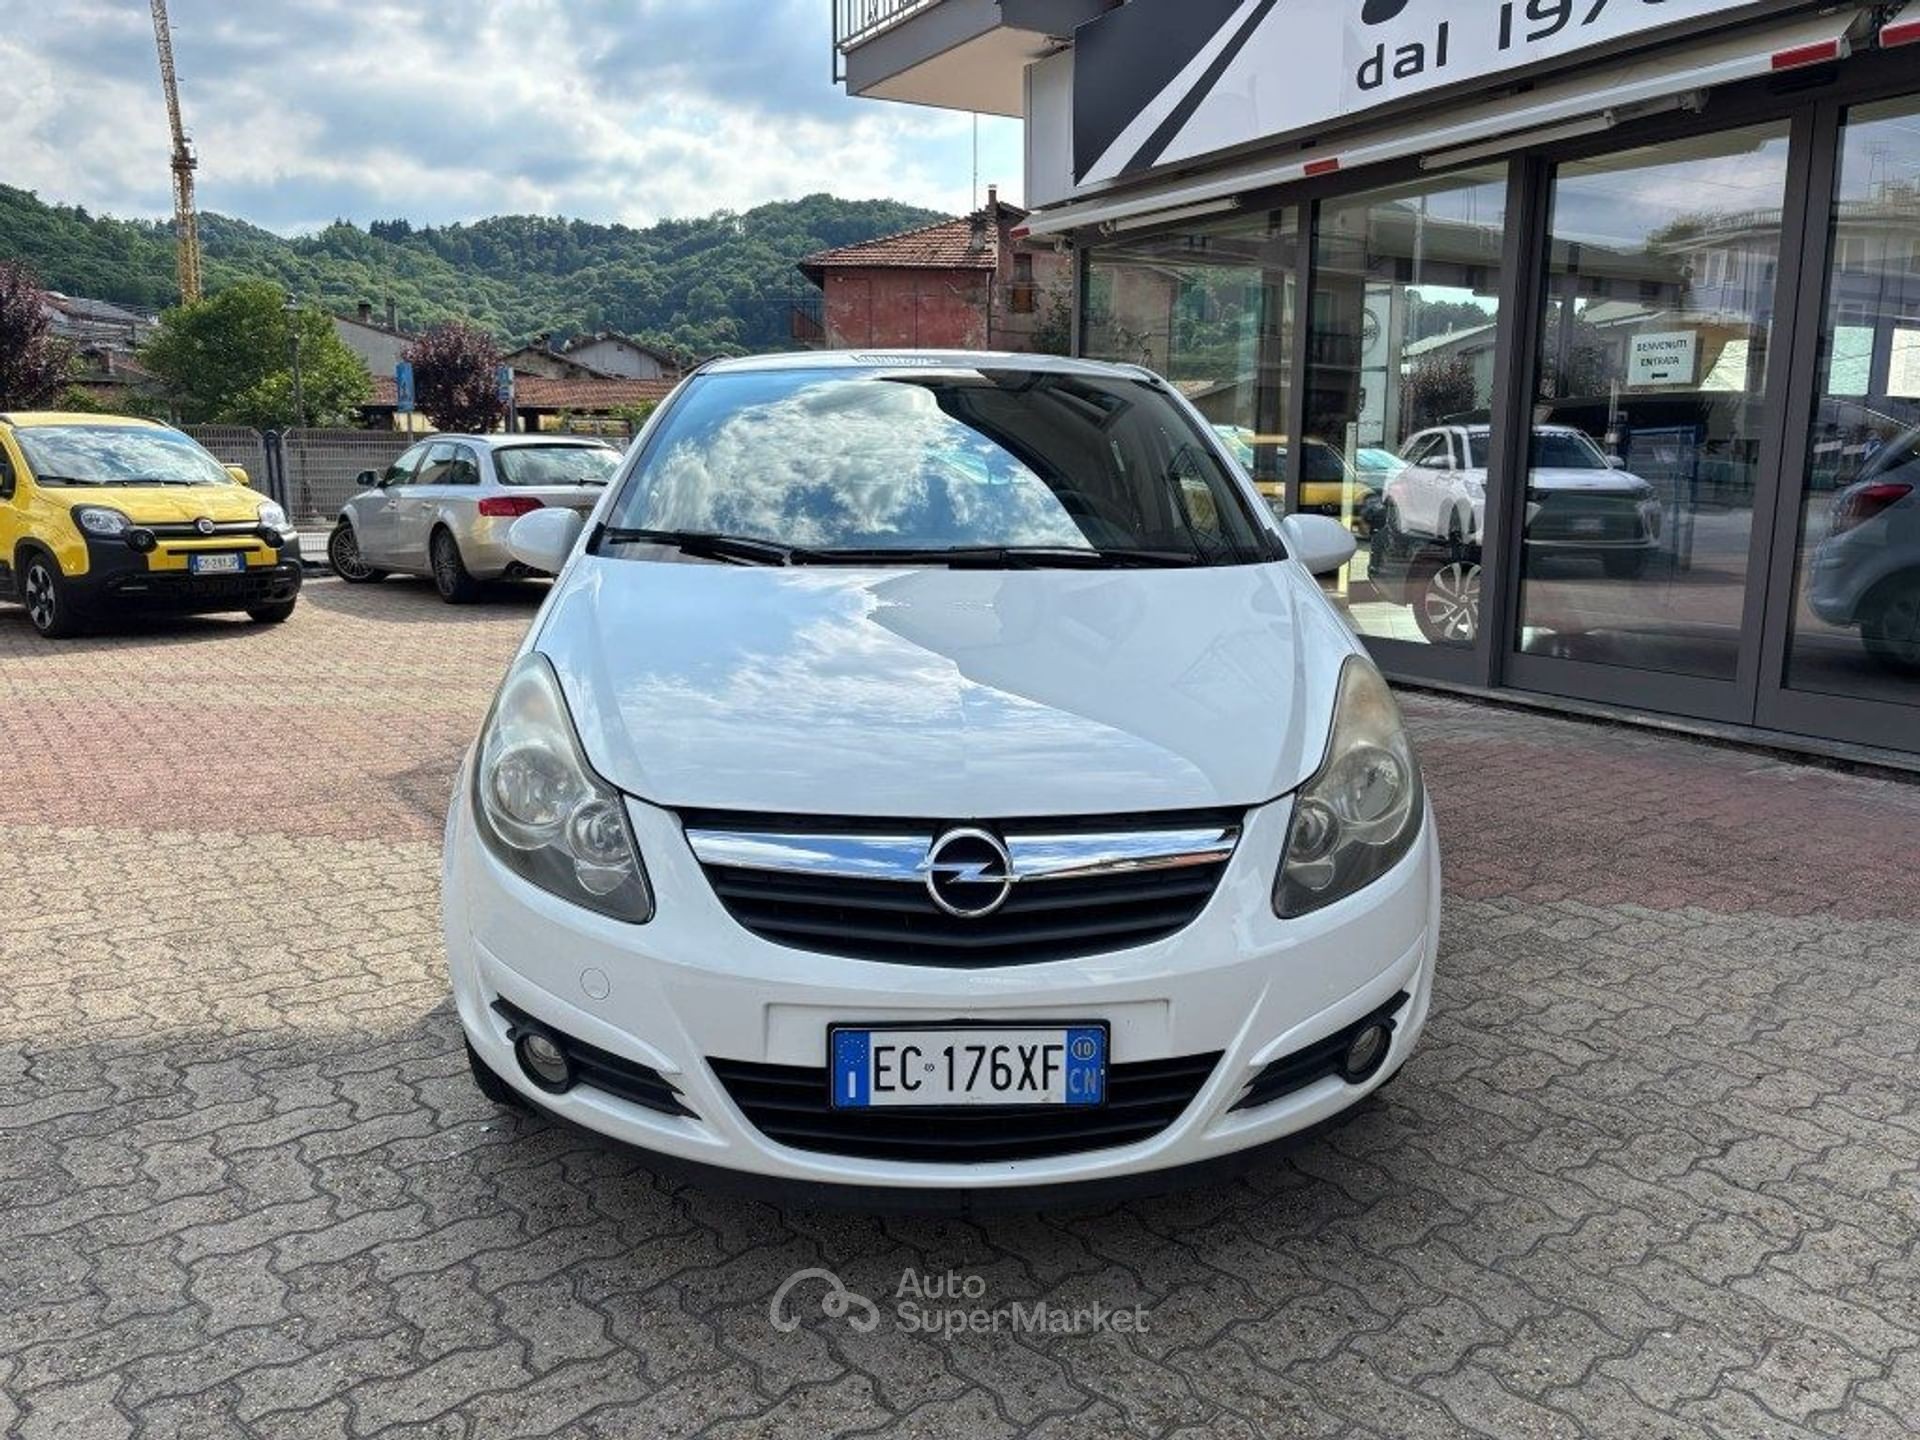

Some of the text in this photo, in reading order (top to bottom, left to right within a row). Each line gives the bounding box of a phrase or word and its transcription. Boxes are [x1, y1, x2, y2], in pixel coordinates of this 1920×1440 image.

[1356, 0, 1664, 91] dal 19
[1640, 356, 1680, 367] ENTRATA
[1076, 1042, 1092, 1056] 10
[873, 1045, 1064, 1092] EC 176XF
[1069, 1067, 1097, 1094] CN
